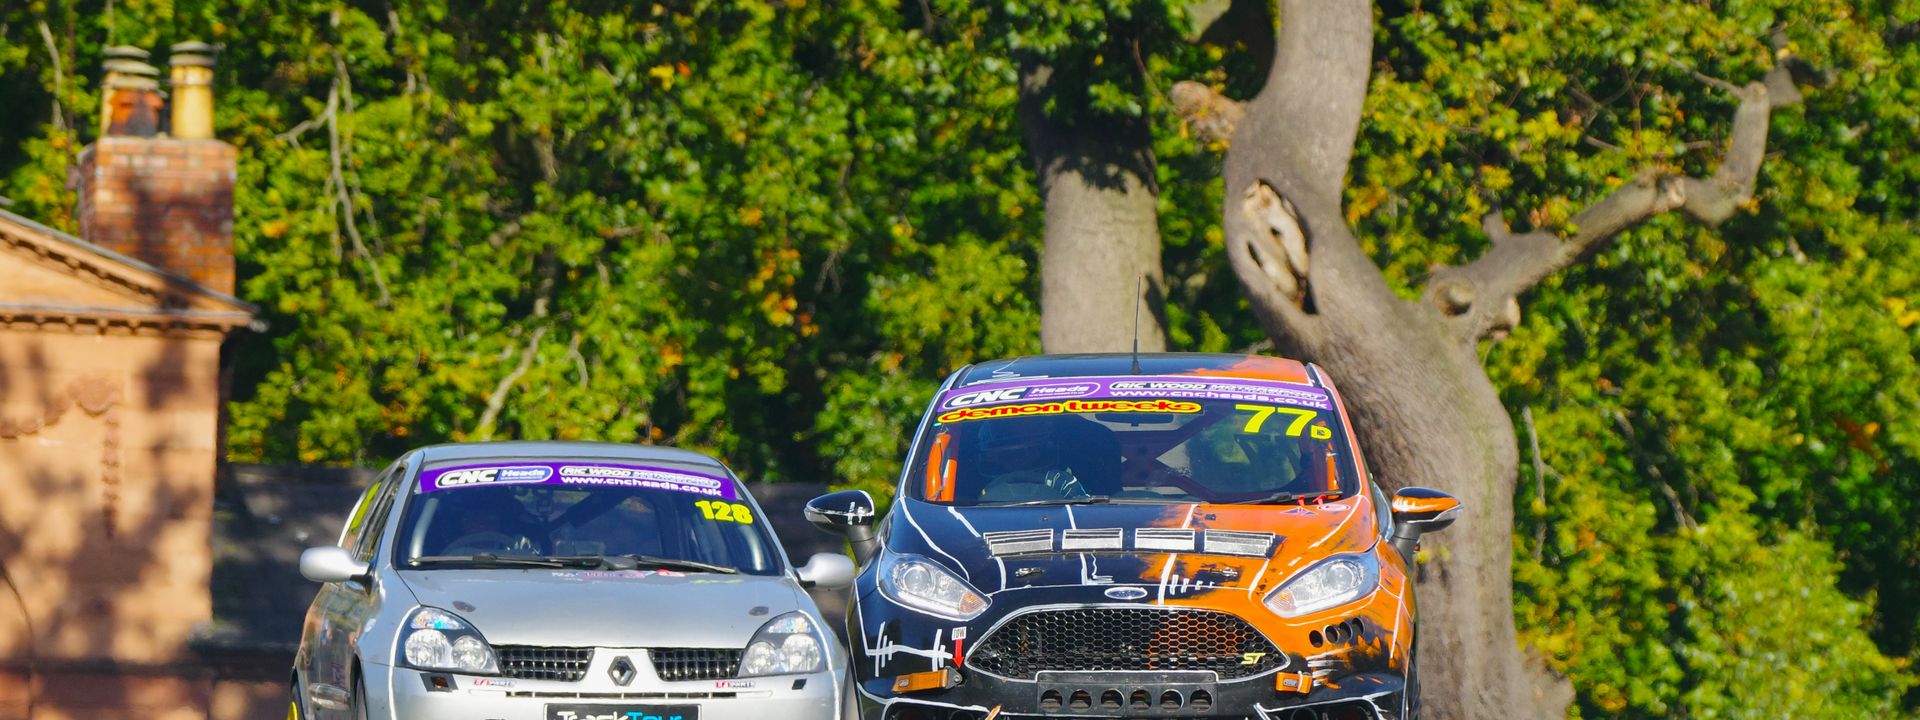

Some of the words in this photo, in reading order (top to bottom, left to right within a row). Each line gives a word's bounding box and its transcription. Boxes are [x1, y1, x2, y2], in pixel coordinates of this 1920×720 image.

[1150, 382, 1207, 390] WOOD
[951, 388, 1027, 406] CNC
[1031, 385, 1090, 394] Heads
[1110, 390, 1328, 409] www.cncheads.co.uk
[441, 469, 498, 486] CNC
[501, 469, 546, 477] Heads
[588, 468, 631, 476] WOOD
[560, 476, 722, 496] www.cncheads.co.uk
[694, 500, 753, 524] 128
[1241, 652, 1266, 664] ST
